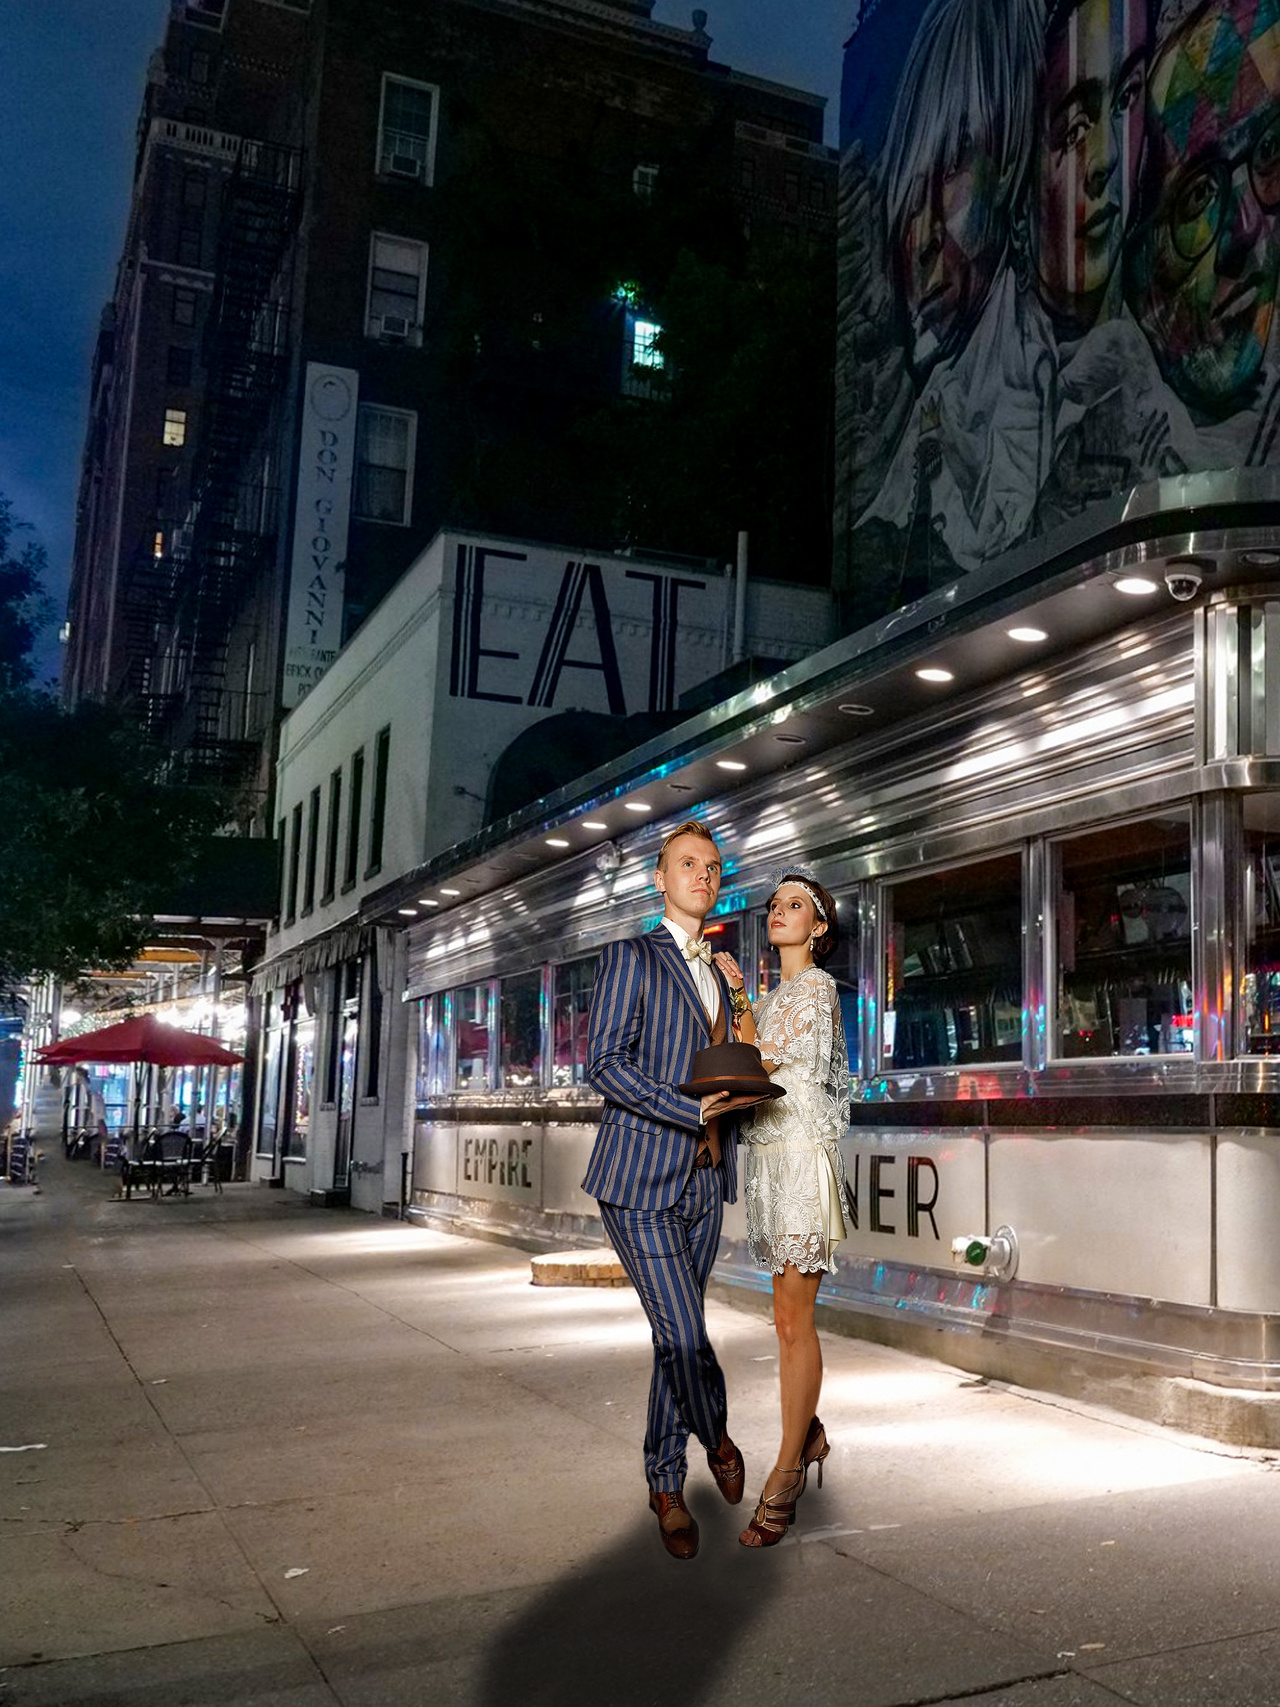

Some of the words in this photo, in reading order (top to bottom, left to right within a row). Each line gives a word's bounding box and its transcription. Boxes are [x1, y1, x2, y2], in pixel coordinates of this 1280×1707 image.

[317, 430, 338, 483] DON
[305, 499, 332, 645] GIOVANNI
[449, 543, 706, 716] EAT
[464, 1138, 532, 1188] EMPIRE
[845, 1154, 940, 1240] NER
